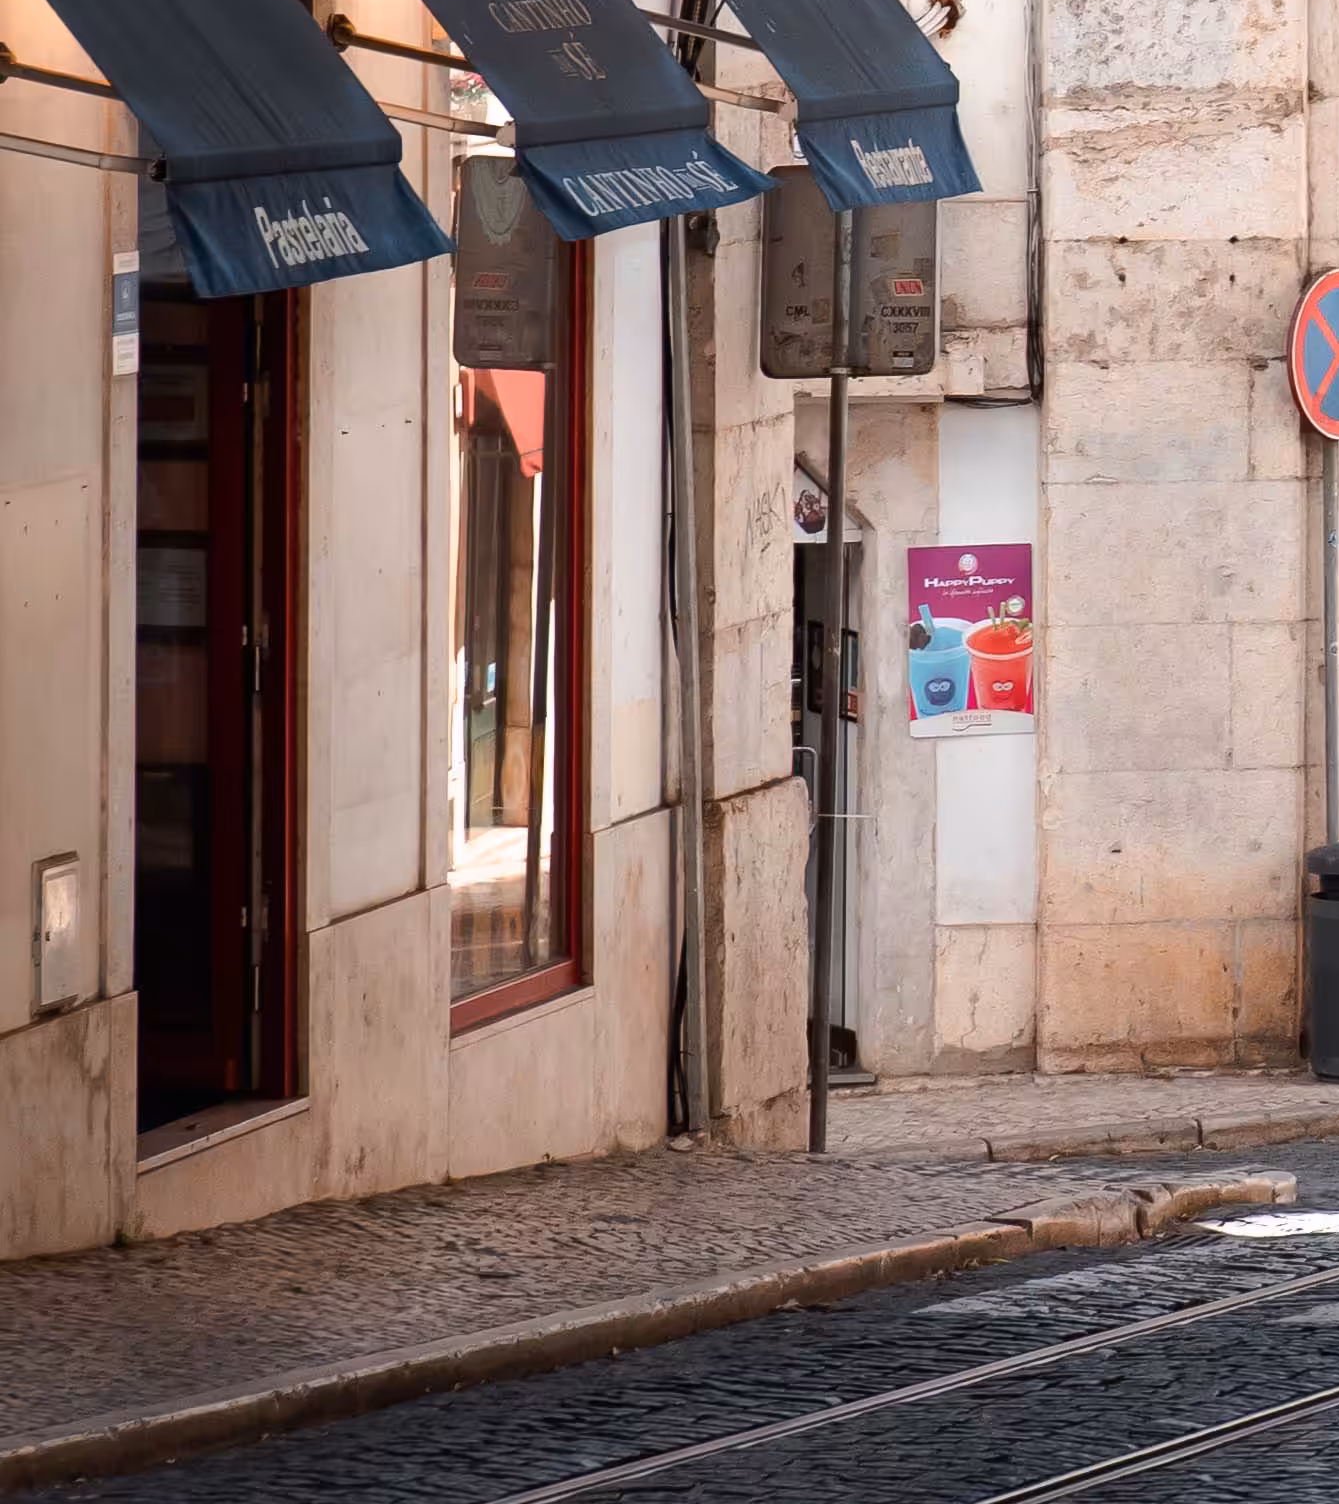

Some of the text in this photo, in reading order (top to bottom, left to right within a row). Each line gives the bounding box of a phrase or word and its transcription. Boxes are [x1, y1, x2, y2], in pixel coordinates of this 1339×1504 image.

[850, 137, 934, 190] Restaurante
[563, 165, 694, 217] CANTINHO
[254, 196, 370, 270] Pastelaria
